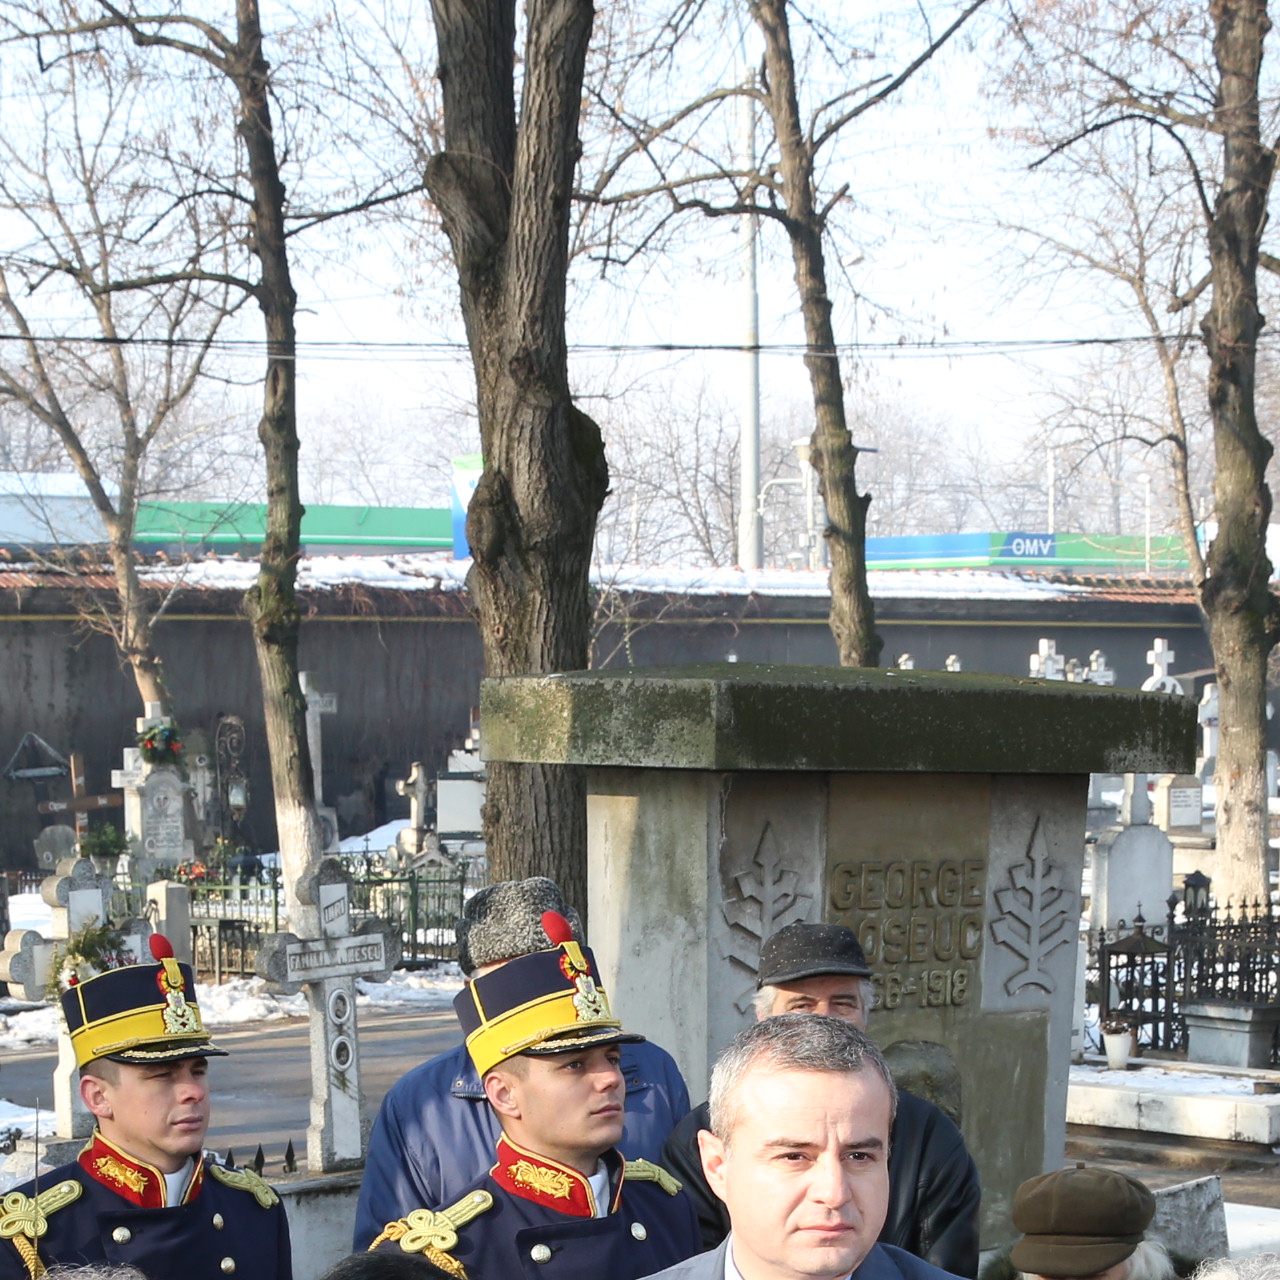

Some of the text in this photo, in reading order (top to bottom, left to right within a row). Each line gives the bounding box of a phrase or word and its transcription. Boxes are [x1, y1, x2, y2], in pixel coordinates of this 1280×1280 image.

[1012, 538, 1052, 556] OMV
[833, 861, 983, 909] GEORGE
[870, 969, 968, 1010] 66-1918
